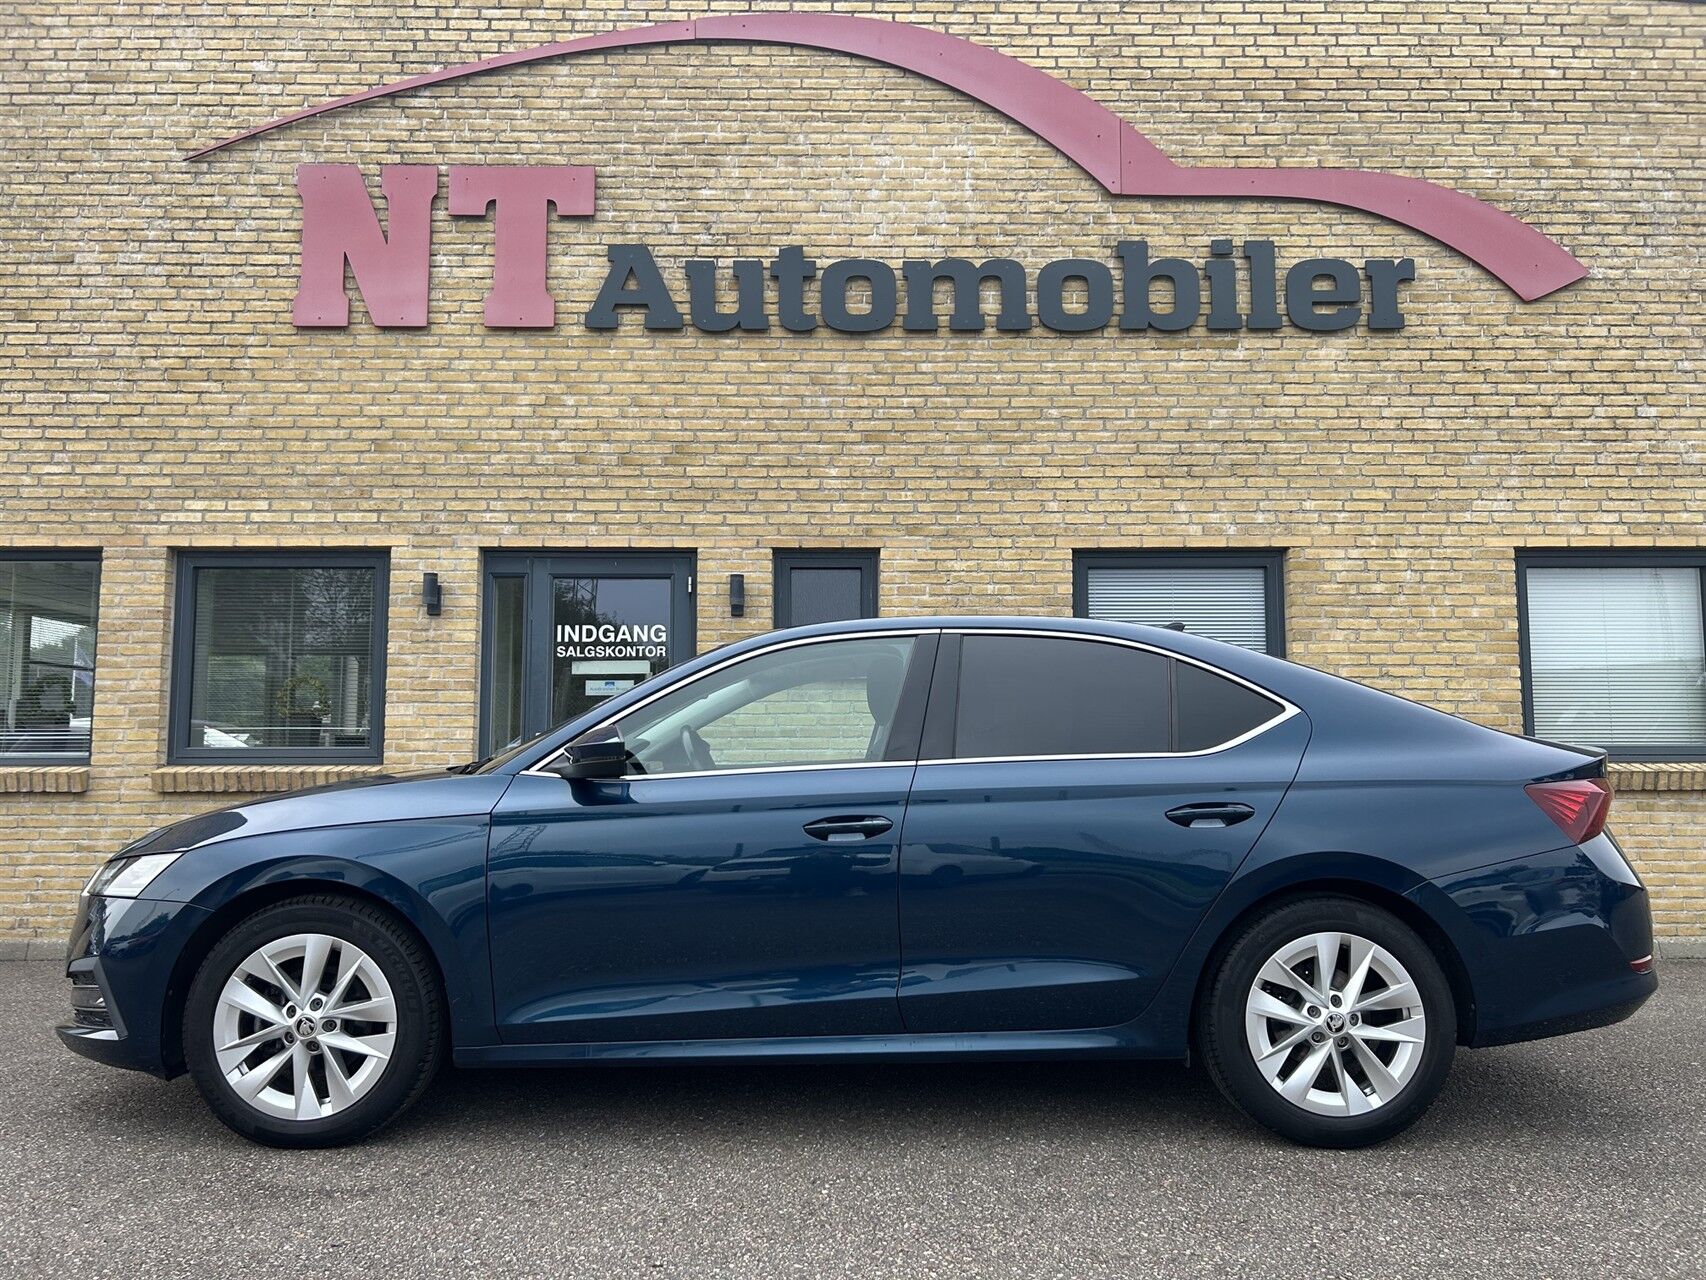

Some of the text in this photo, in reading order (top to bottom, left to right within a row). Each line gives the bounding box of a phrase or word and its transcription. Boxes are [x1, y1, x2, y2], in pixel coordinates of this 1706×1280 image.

[293, 164, 1415, 332] NT Automobiler
[556, 624, 667, 643] INDGANG
[556, 645, 667, 658] SALGSKONTOR
